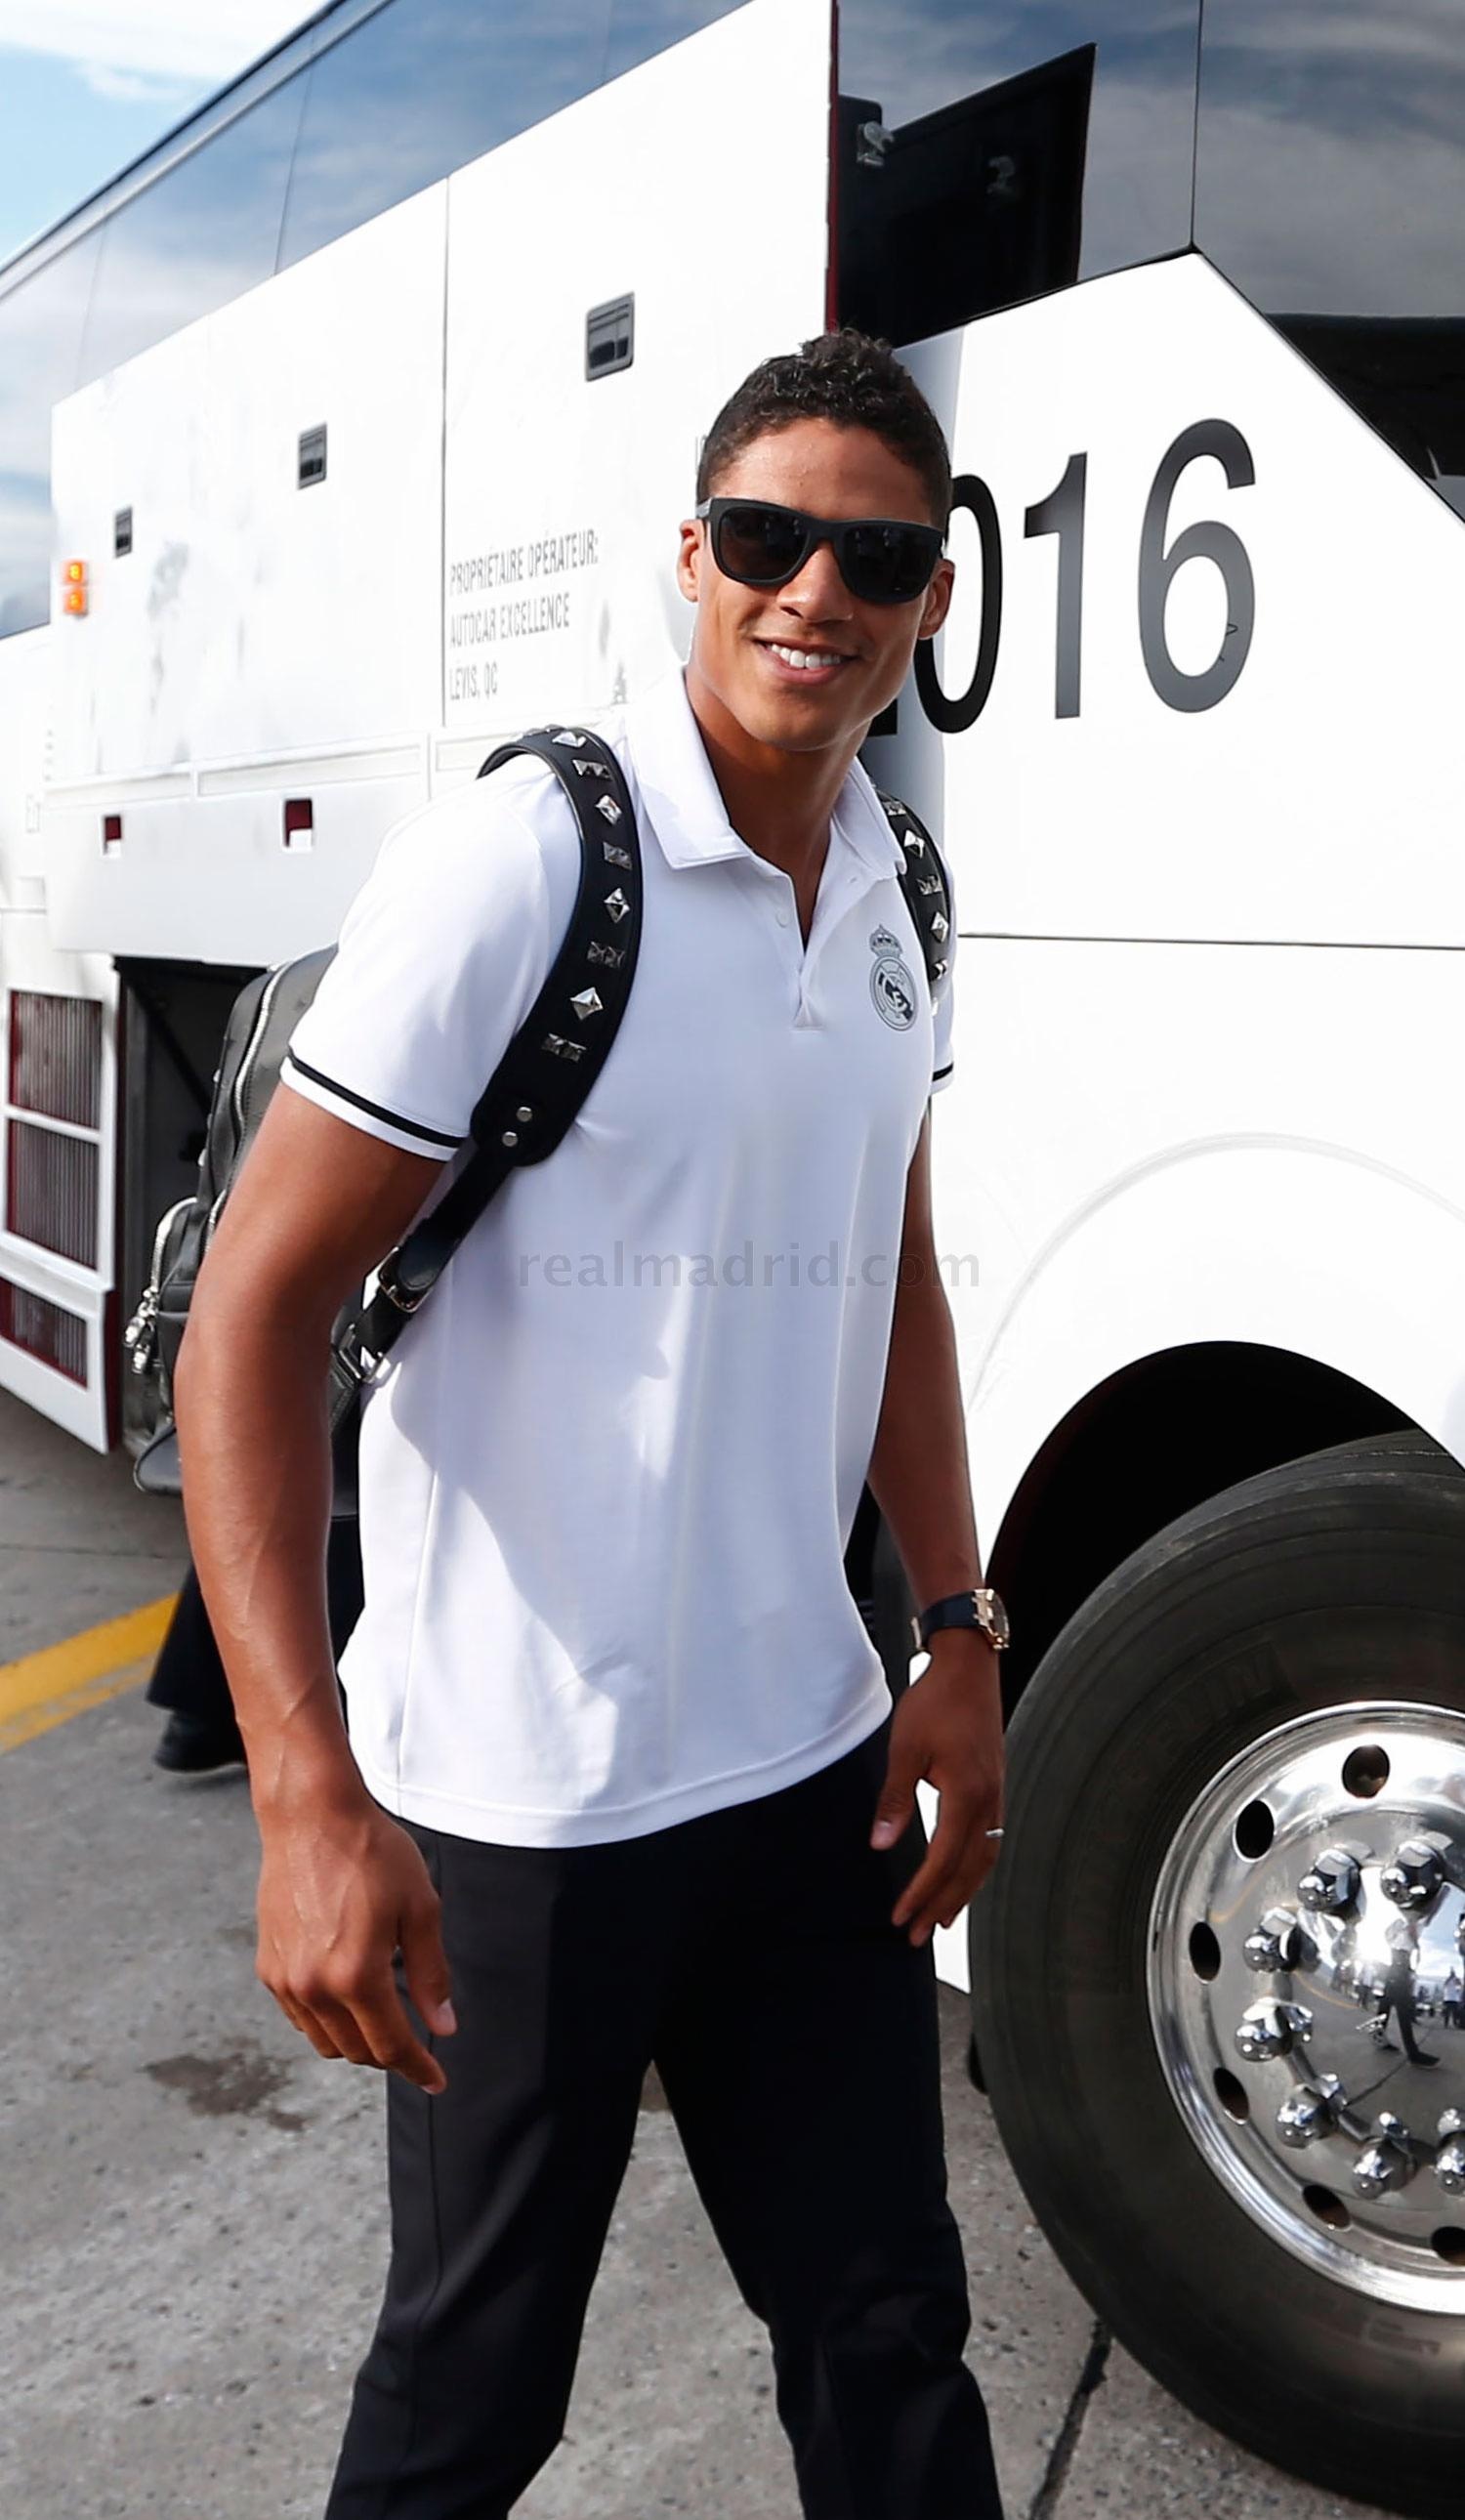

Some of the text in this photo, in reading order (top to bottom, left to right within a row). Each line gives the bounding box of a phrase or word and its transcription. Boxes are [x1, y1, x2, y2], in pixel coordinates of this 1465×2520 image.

[868, 417, 1256, 736] 016
[449, 591, 569, 649] AUTOCAR EXCELLENCE
[484, 660, 498, 699] QC
